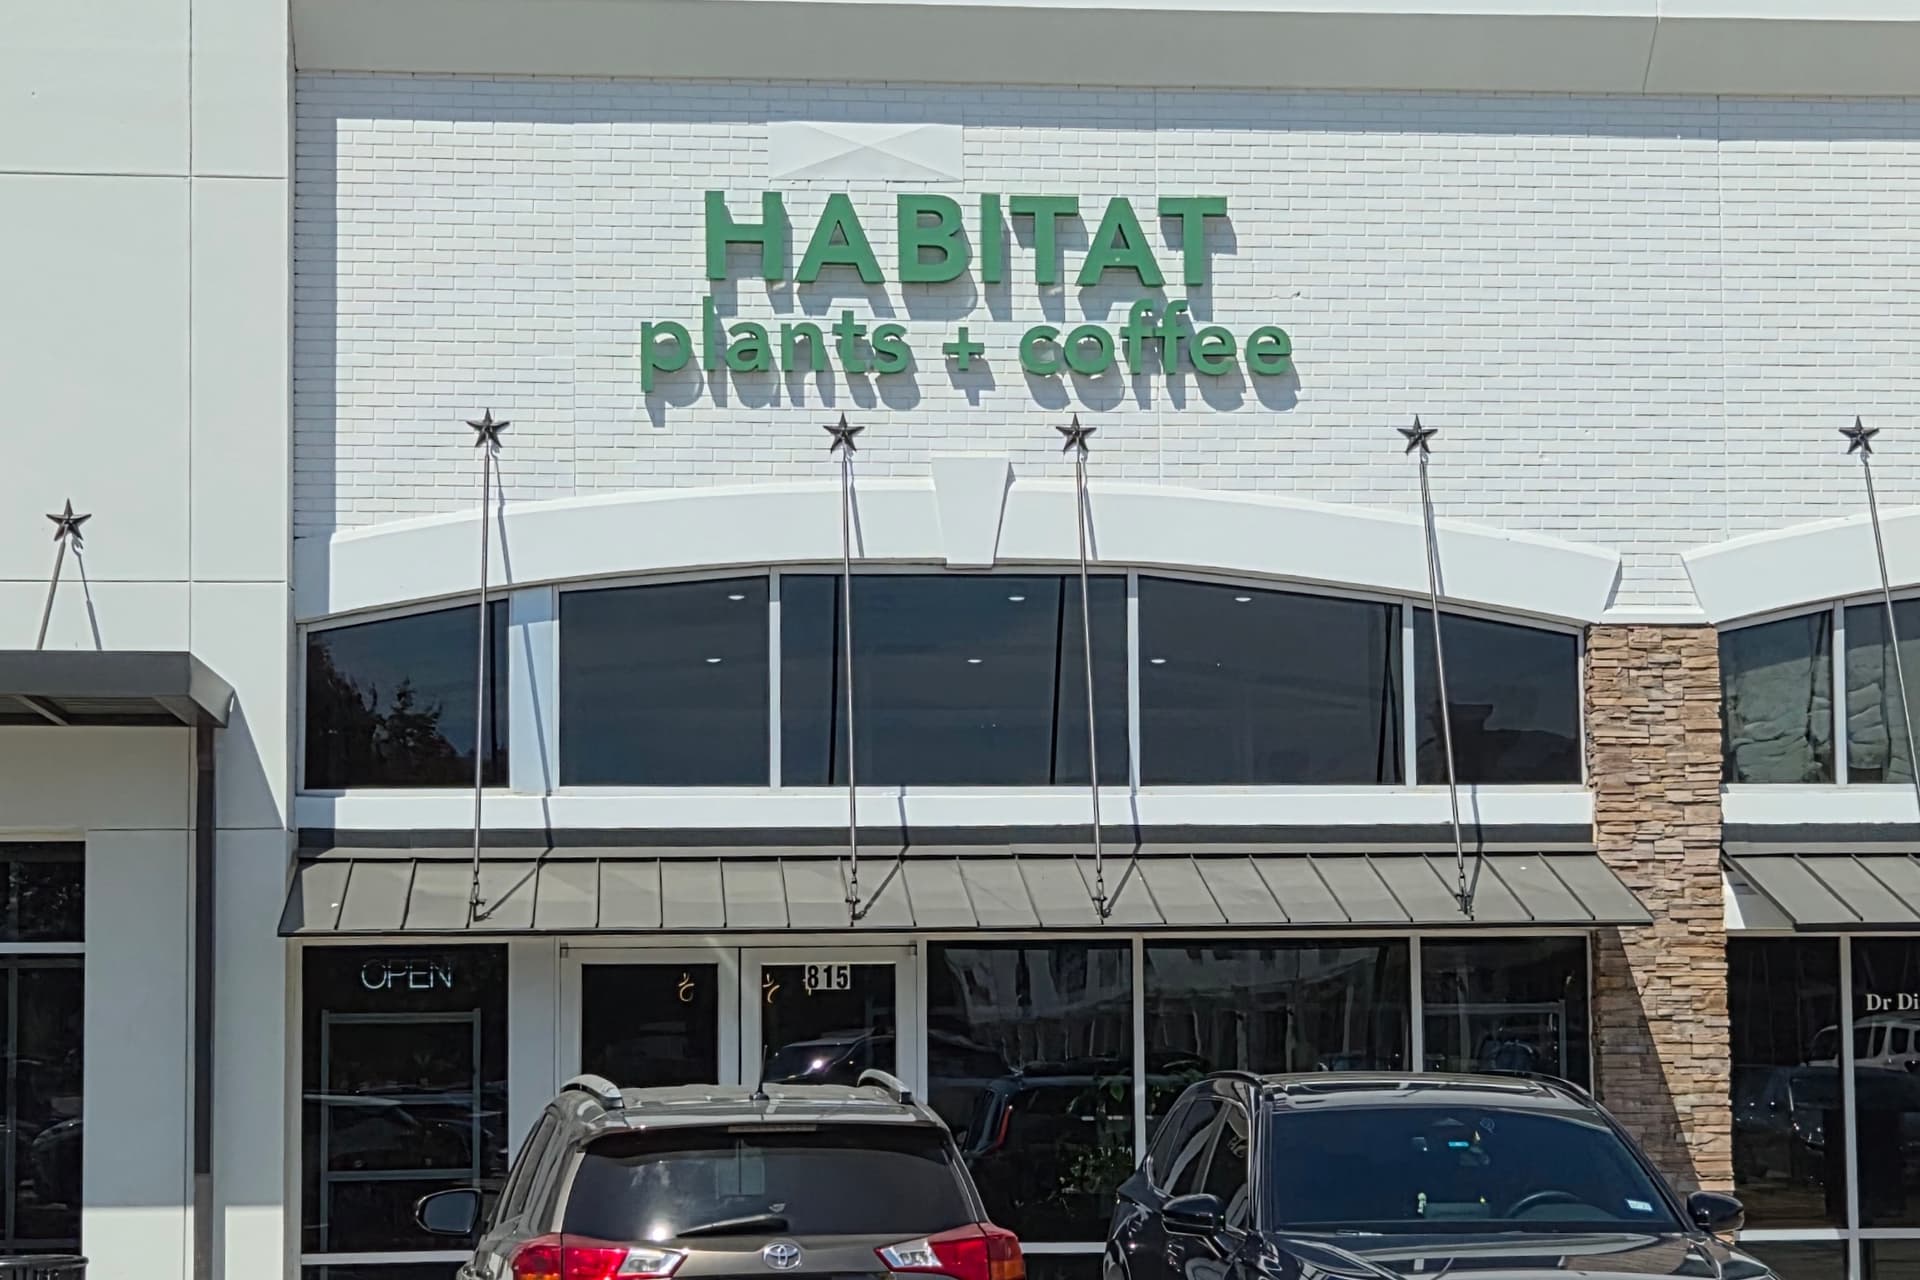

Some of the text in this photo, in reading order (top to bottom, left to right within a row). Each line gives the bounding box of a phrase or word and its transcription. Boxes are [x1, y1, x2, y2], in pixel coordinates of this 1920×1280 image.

[705, 191, 1227, 287] HABITAT
[641, 296, 1292, 393] plants + coffee
[361, 959, 452, 990] OPEN
[807, 965, 849, 989] 815
[1866, 993, 1892, 1011] Dr
